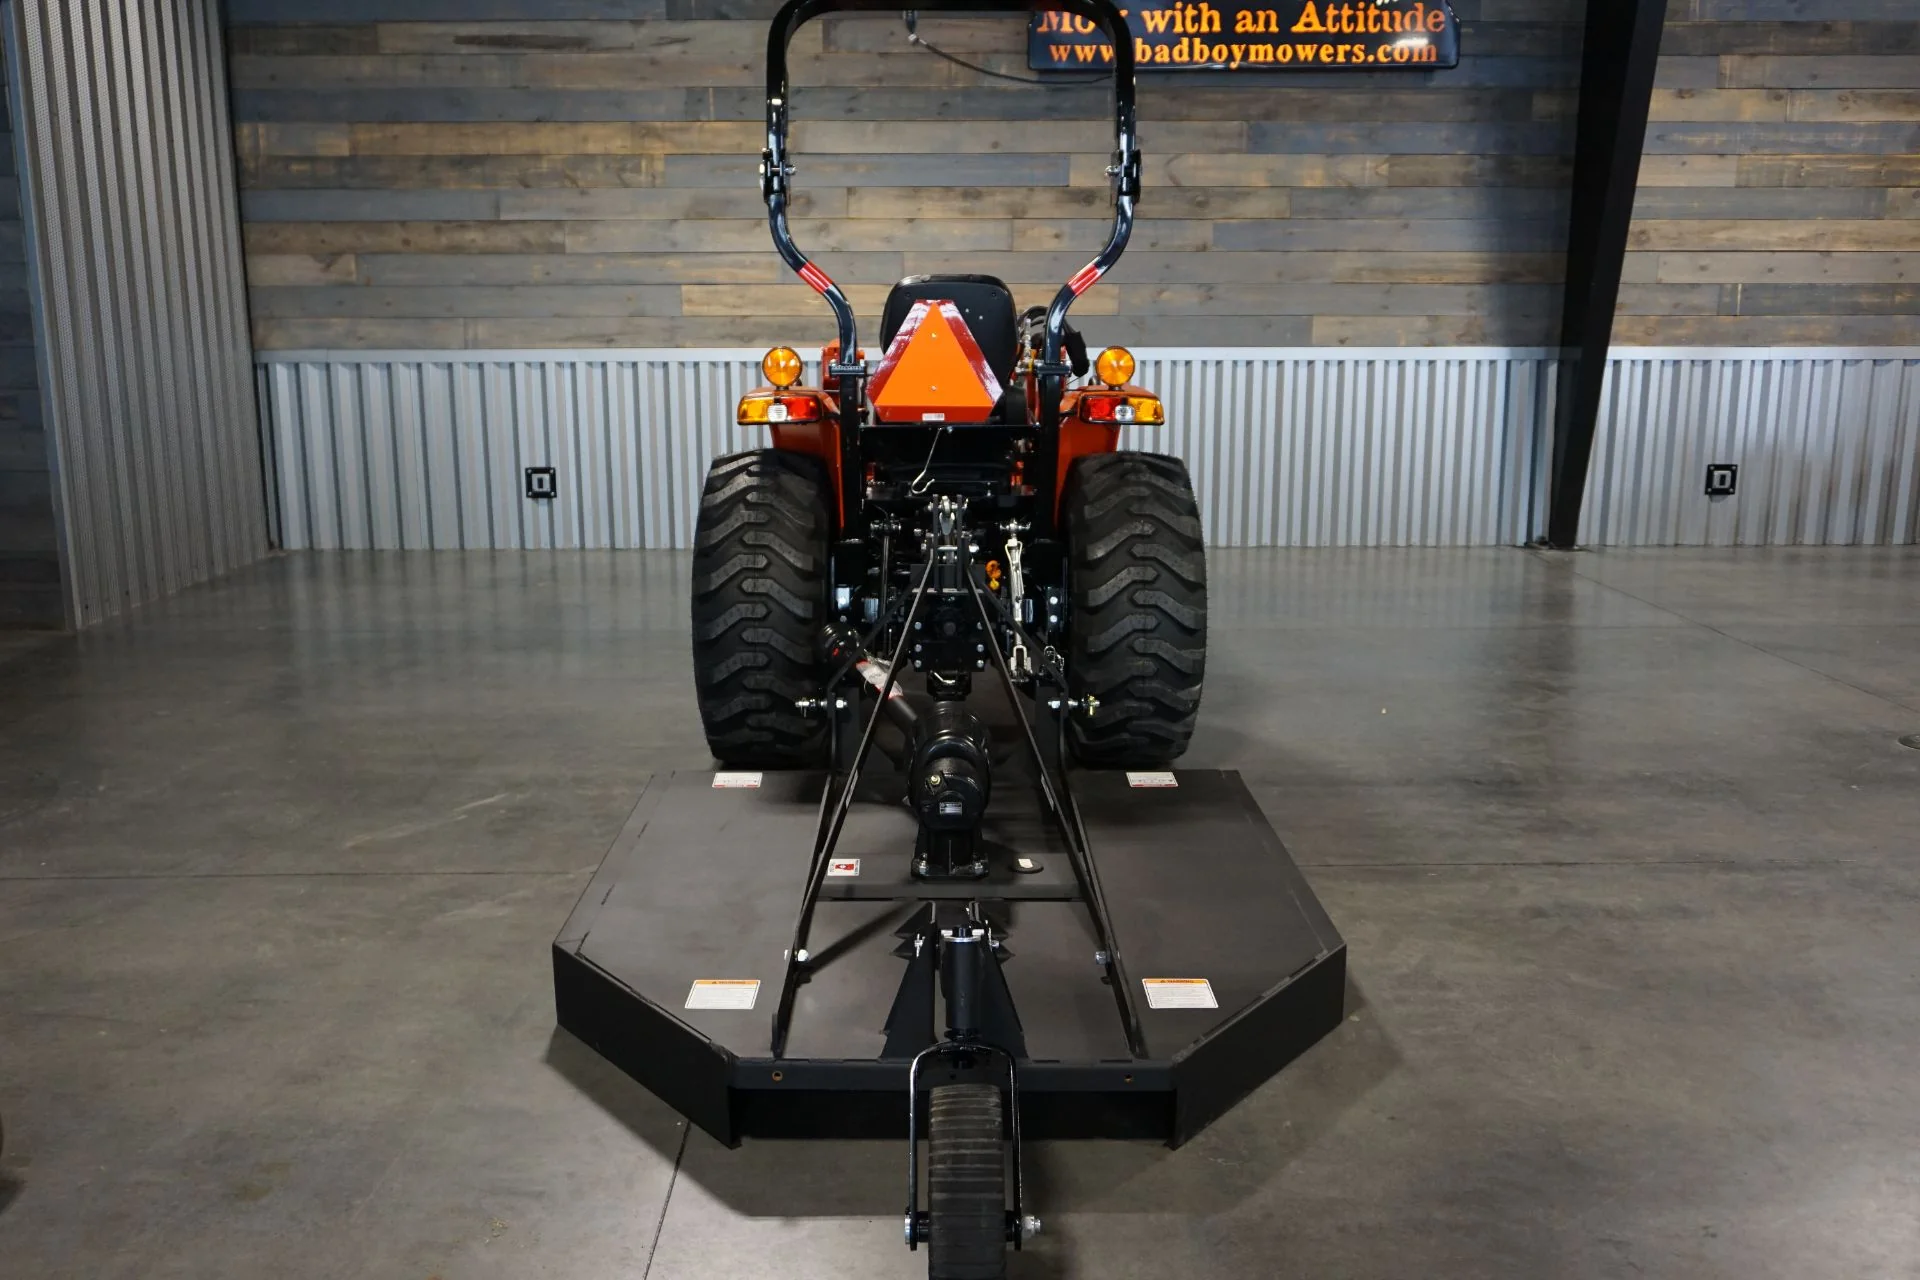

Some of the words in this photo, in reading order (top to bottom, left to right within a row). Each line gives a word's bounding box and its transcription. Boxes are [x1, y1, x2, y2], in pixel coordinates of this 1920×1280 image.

[1036, 9, 1129, 34] Mo
[1140, 3, 1222, 34] with
[1234, 9, 1279, 34] an
[1290, 2, 1446, 34] Attitude
[1048, 37, 1438, 69] wwwbadboymowers.com
